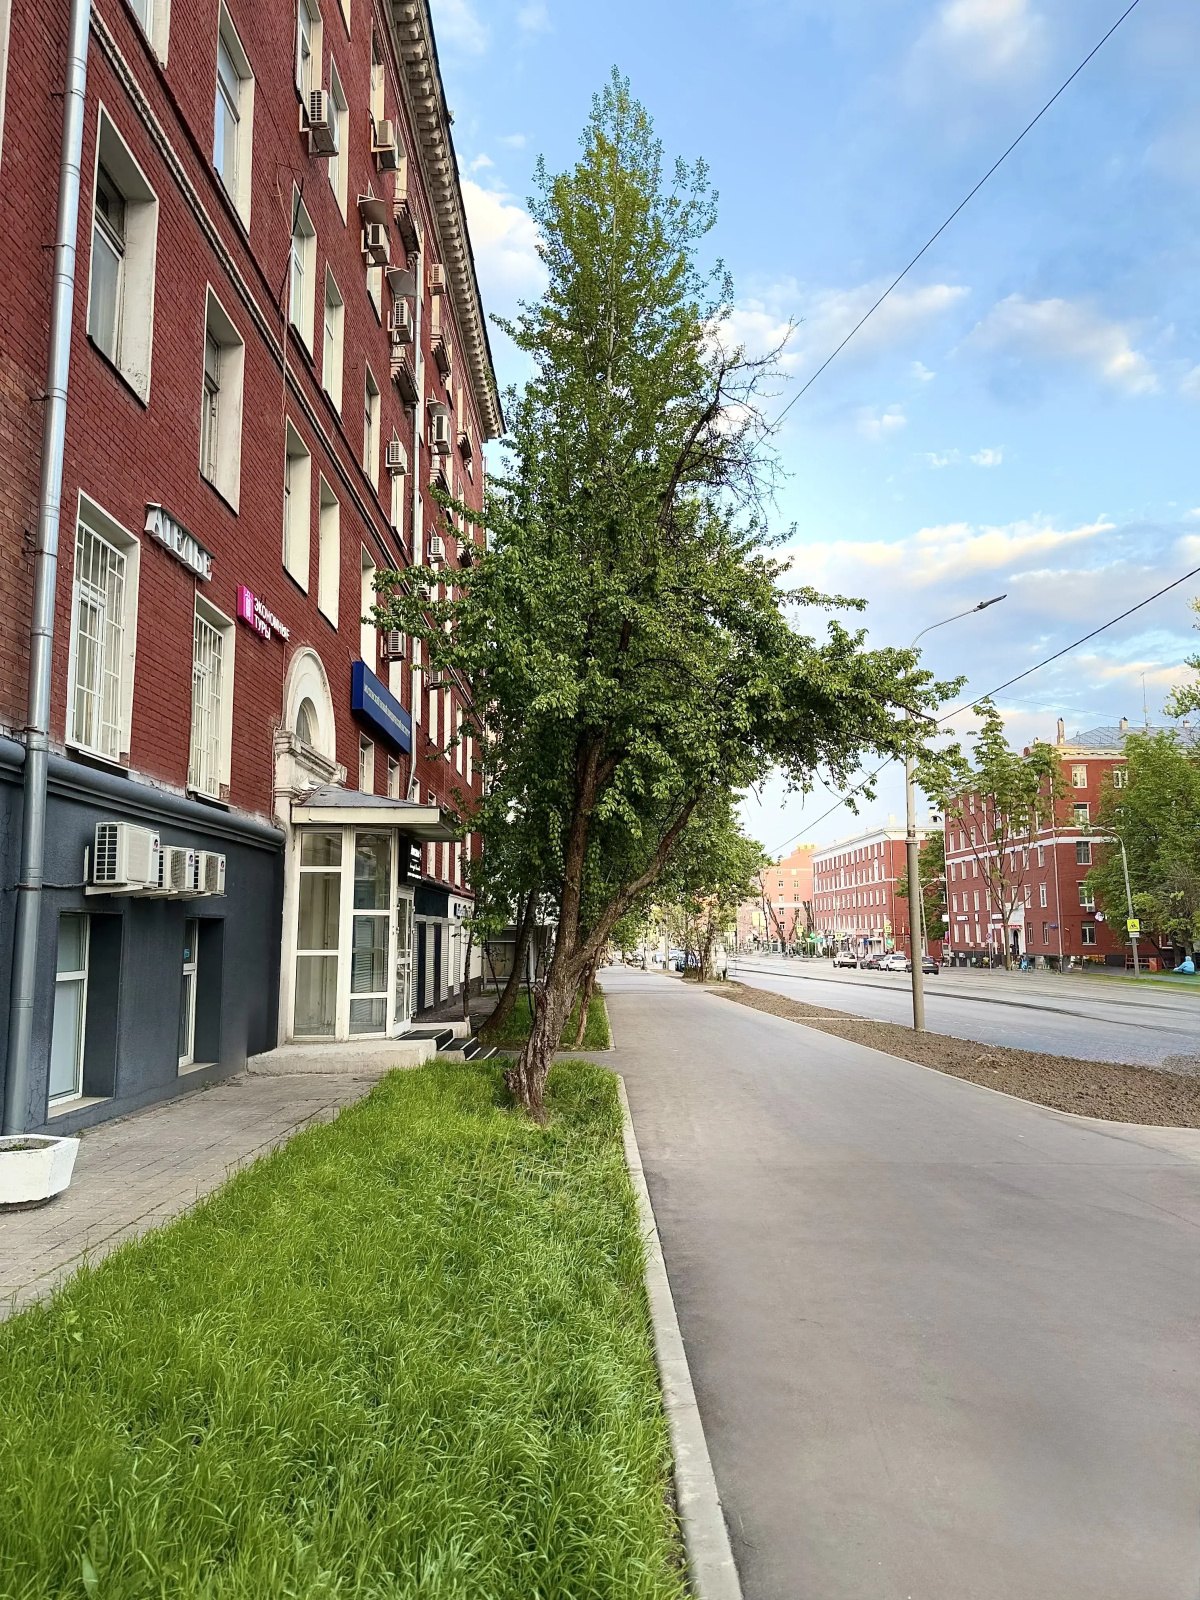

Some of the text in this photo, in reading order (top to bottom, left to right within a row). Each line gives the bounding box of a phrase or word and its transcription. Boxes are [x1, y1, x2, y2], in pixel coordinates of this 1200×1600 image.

[145, 508, 213, 582] АТЕЛЬЕ
[254, 597, 291, 642] ЭКОНОМНЫЕ
[254, 614, 271, 641] ТУРЫ
